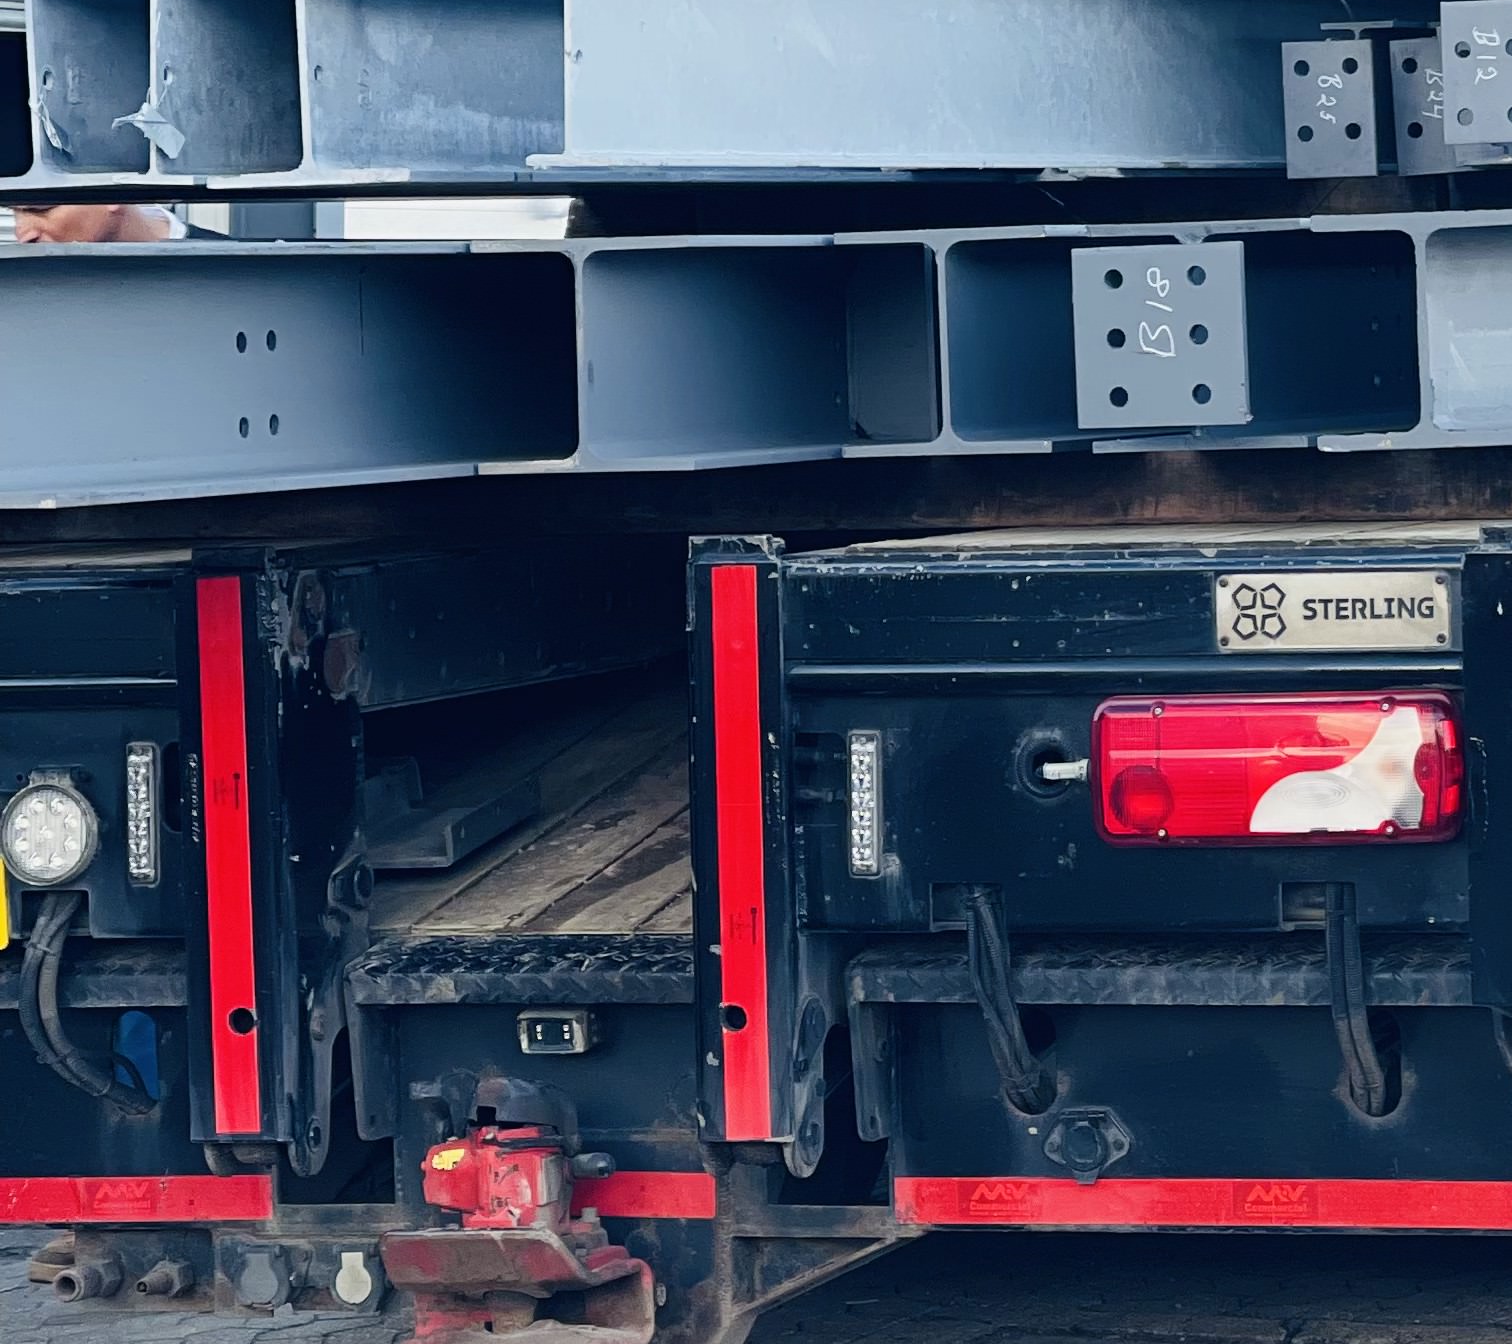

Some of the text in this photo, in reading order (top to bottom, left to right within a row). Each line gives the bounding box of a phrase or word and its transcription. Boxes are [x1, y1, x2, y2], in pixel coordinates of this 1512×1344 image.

[1471, 26, 1501, 86] B12
[1316, 74, 1343, 124] B25
[1138, 267, 1177, 357] B18
[1302, 597, 1435, 621] STERLING
